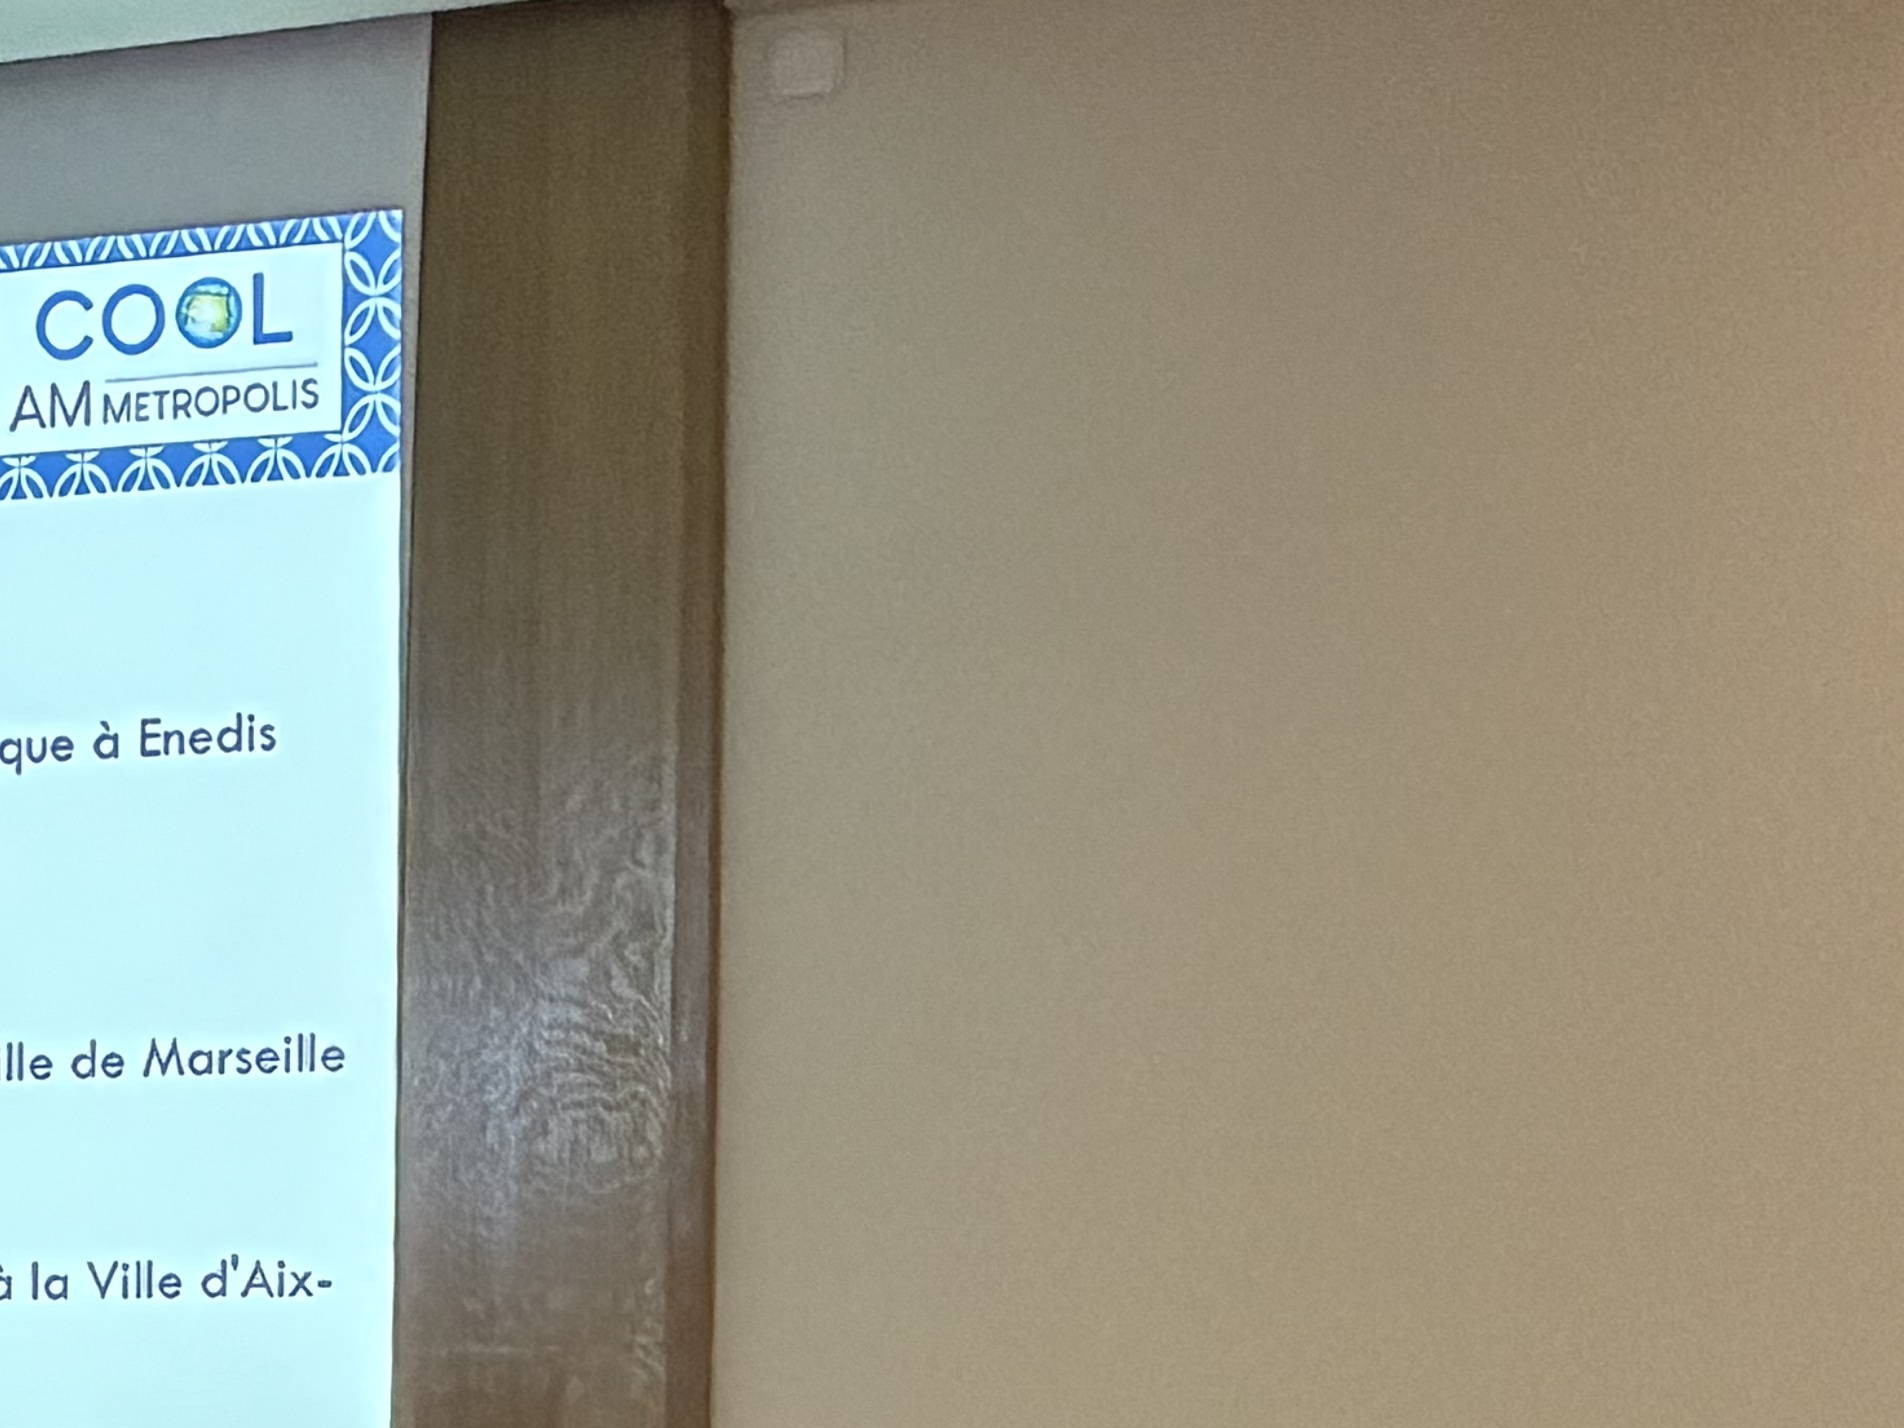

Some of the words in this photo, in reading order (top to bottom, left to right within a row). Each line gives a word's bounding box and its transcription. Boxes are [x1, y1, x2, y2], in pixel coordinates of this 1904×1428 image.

[35, 271, 293, 361] COOL
[8, 379, 92, 433] AM
[101, 377, 320, 425] METROPOLIS
[91, 719, 121, 761] à
[138, 710, 278, 759] Enedis
[69, 1037, 126, 1081] de
[141, 1031, 347, 1079] Marseille
[30, 1259, 70, 1302] la
[85, 1258, 184, 1301] Ville
[199, 1253, 334, 1300] d'Aix-
